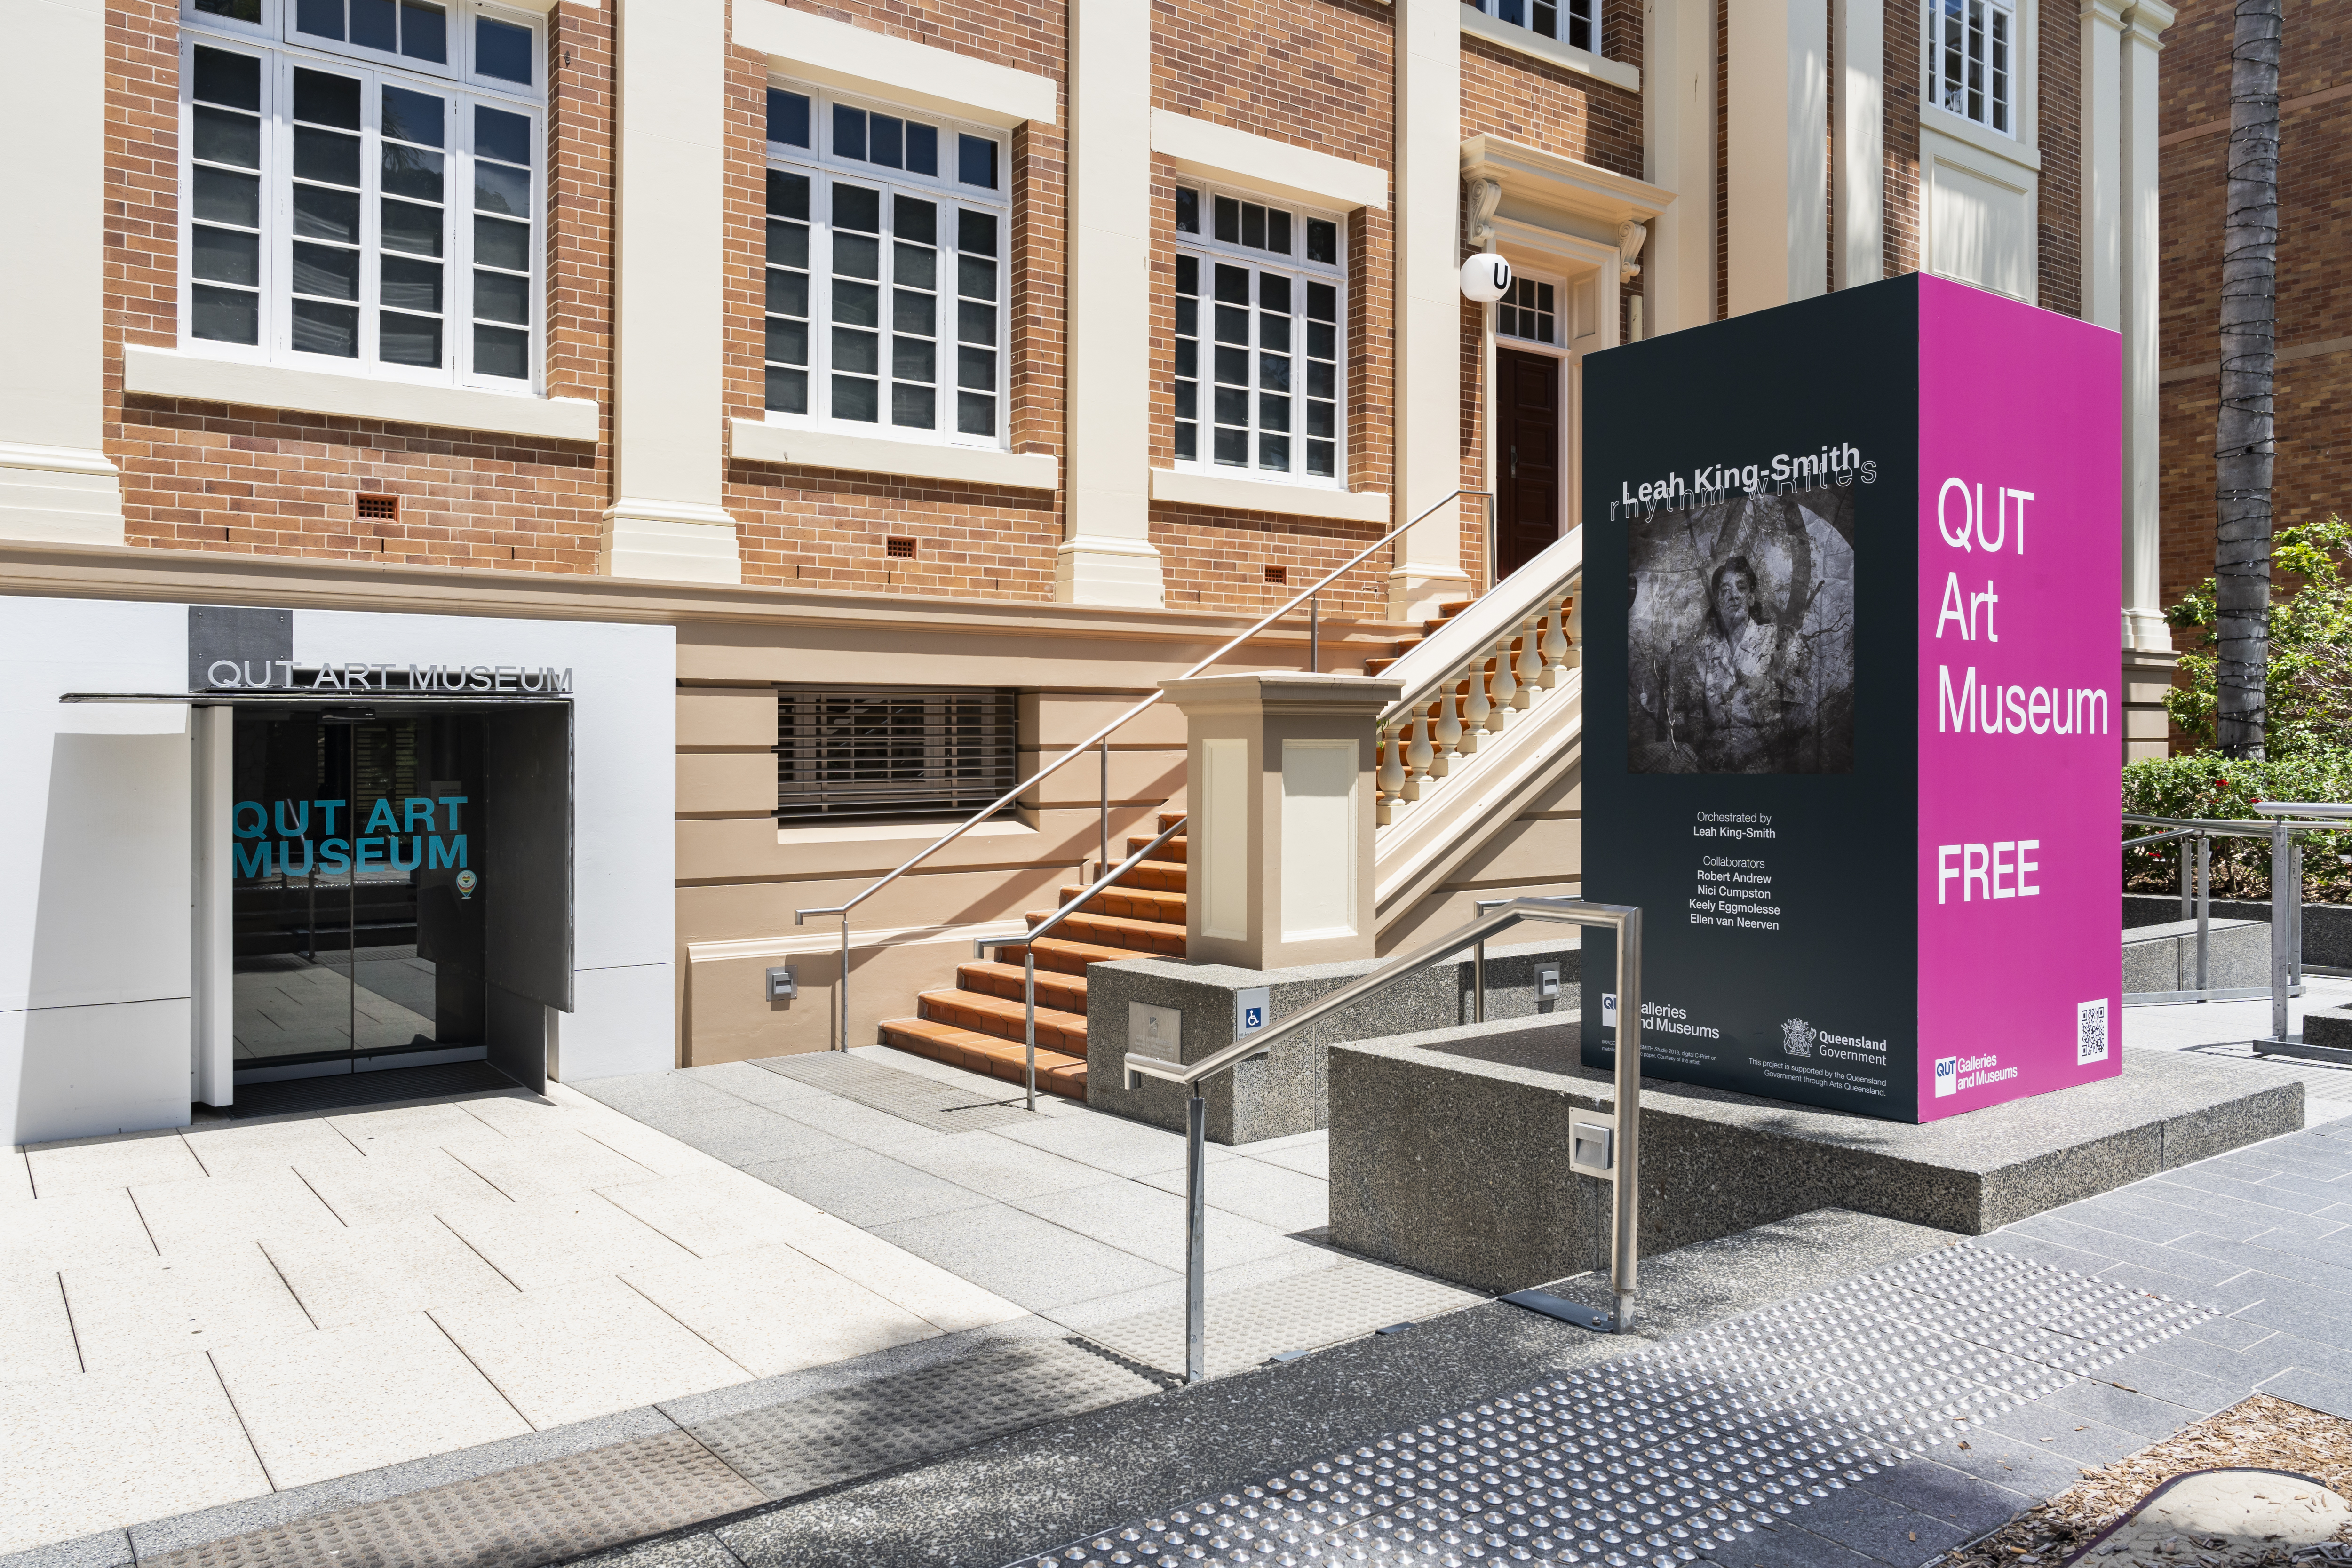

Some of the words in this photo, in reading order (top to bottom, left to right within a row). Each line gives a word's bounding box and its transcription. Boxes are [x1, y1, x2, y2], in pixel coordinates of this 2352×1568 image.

[1494, 262, 1508, 290] U
[1623, 472, 1684, 505] Leah
[1695, 442, 1859, 493] King-Smith
[1938, 477, 2034, 555] QUT
[1935, 572, 1998, 643] Art
[208, 660, 302, 688] QUT
[312, 662, 396, 690] ART
[409, 663, 573, 692] MUSEUM
[1939, 664, 2108, 735] Museum
[232, 800, 346, 840] QUT
[364, 796, 468, 834] ART
[1697, 811, 1757, 823] Orchestrated
[1760, 812, 1772, 825] by
[1693, 826, 1717, 837] Leah
[1720, 827, 1776, 839] King-Smith
[232, 834, 468, 879] MUSEUM
[1703, 855, 1765, 868] Collaborators
[1697, 870, 1730, 882] Robert
[1732, 872, 1772, 884] Andrew
[1939, 839, 2040, 905] FREE
[1698, 884, 1716, 895] Nici
[1719, 886, 1771, 899] Cumpston
[1689, 899, 1716, 912] Keely
[1718, 900, 1780, 915] Eggmolesse
[1690, 913, 1714, 925] Ellen
[1716, 917, 1734, 926] van
[1737, 917, 1779, 930] Neerven
[1640, 1001, 1687, 1019] alleries
[1640, 1016, 1654, 1030] nd
[1656, 1017, 1720, 1039] Museums
[1819, 1030, 1887, 1051] Queensland
[1657, 1053, 1676, 1062] Courtesy
[1819, 1044, 1887, 1066] Government
[1936, 1060, 1955, 1077] QUT
[1957, 1053, 1997, 1073] Galleries
[1749, 1057, 1761, 1066] This
[1763, 1060, 1783, 1069] project
[1791, 1064, 1823, 1076] supported
[1824, 1069, 1833, 1078] by
[1834, 1071, 1845, 1079] the
[1846, 1073, 1886, 1087] Queensland
[1764, 1069, 1802, 1082] Government
[1803, 1075, 1828, 1087] through
[1829, 1080, 1843, 1089] Arts
[1844, 1082, 1886, 1097] Queensland.
[1957, 1072, 1975, 1090] and
[1976, 1066, 2018, 1086] Museums
